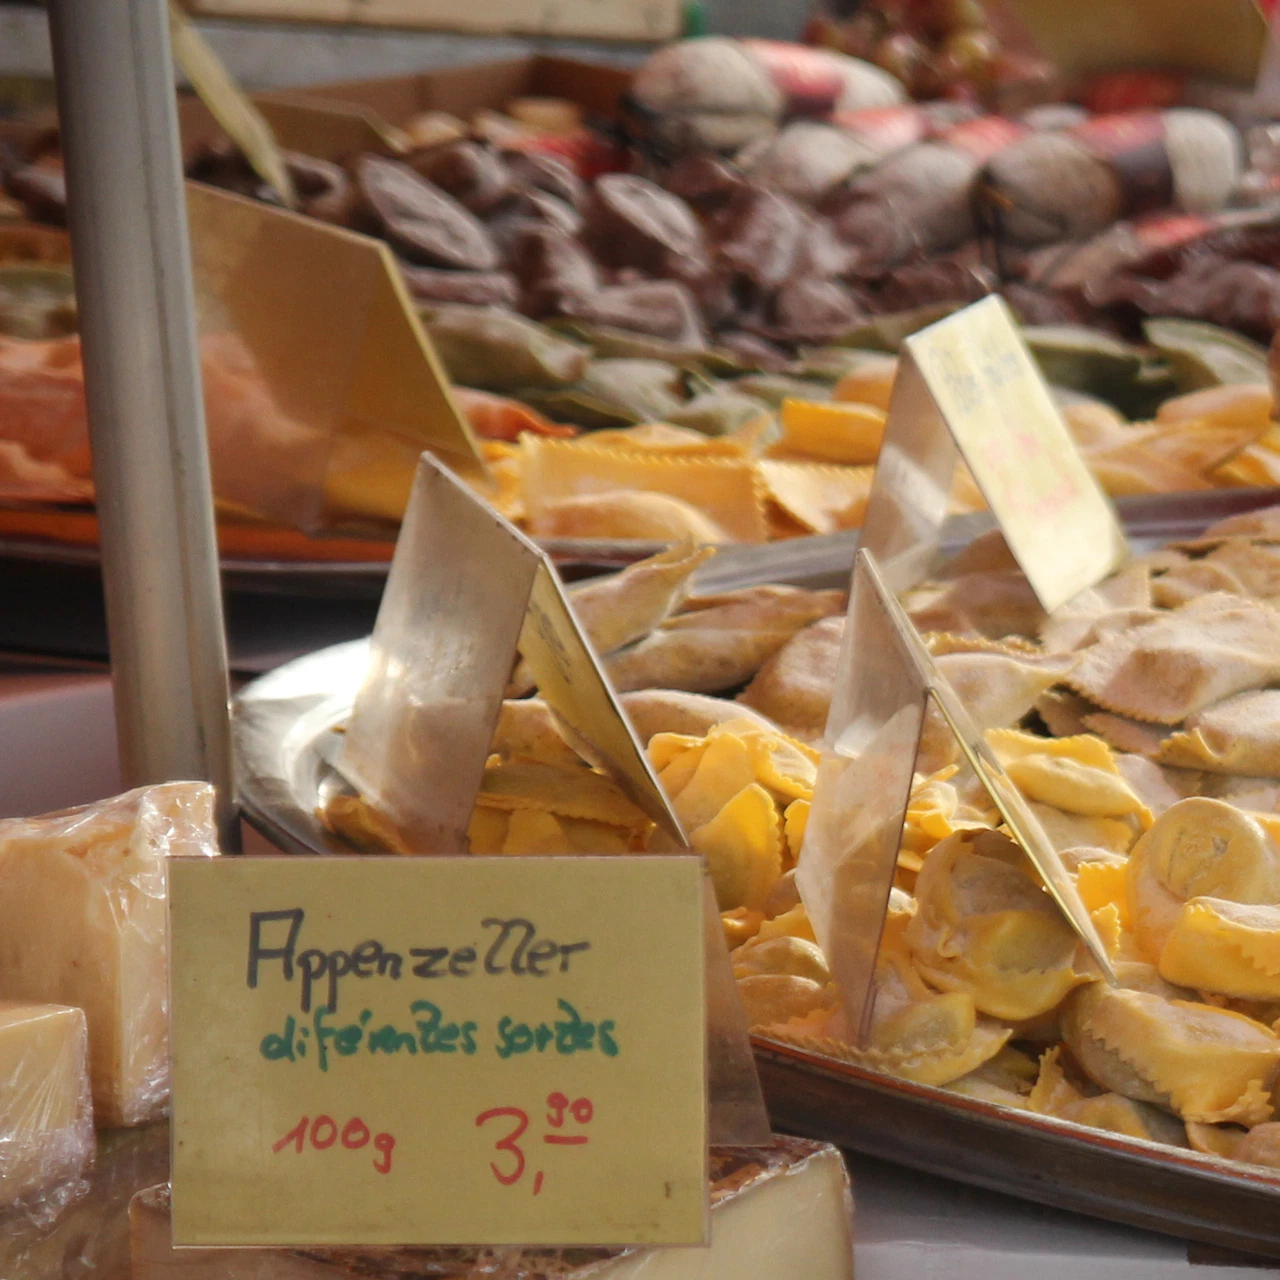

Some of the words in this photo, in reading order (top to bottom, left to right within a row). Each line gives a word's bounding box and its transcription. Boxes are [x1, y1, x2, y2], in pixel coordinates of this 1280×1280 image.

[246, 907, 592, 1014] Appenzeller
[495, 998, 620, 1058] sortes
[271, 1115, 397, 1175] 100g
